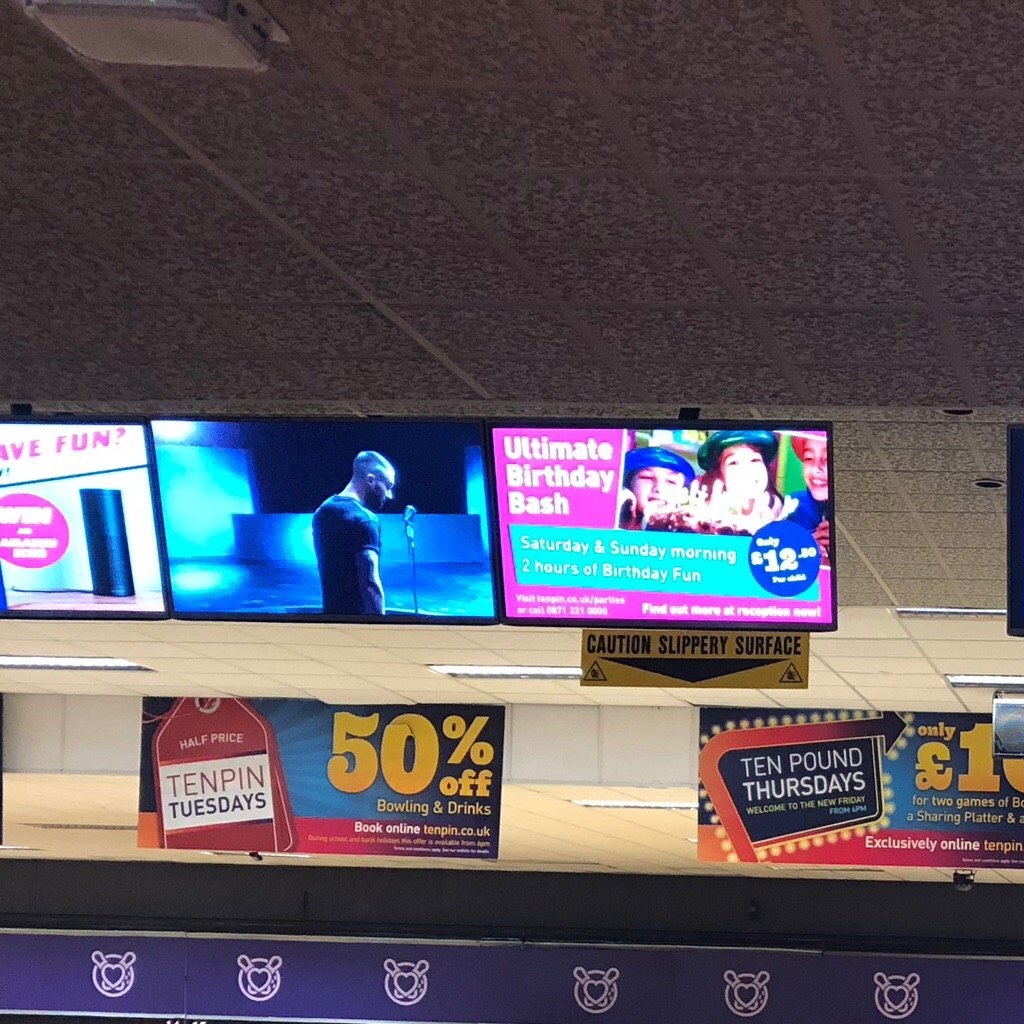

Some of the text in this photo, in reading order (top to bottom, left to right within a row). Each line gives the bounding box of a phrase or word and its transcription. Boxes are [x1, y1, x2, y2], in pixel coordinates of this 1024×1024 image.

[56, 427, 125, 453] FUN?
[503, 435, 613, 460] Ultimate
[506, 464, 615, 493] Birthday
[508, 491, 570, 515] Bash
[520, 535, 737, 565] Saturday & Sunday morning
[522, 559, 701, 583] 2 hours of Birthday Fun
[528, 606, 544, 614] call
[642, 603, 668, 615] Find
[669, 604, 689, 615] out
[690, 605, 721, 615] more
[723, 605, 735, 616] at
[737, 605, 791, 618] reception
[587, 634, 802, 656] CAUTION SLIPPERY SURFACE
[179, 733, 244, 750] HALF PRICE
[918, 721, 956, 741] only
[327, 711, 494, 795] 50%
[740, 747, 863, 778] TEN POUND
[166, 765, 264, 798] TENPIN
[439, 768, 493, 797] off
[742, 771, 866, 801] THURSDAYS
[168, 792, 267, 819] TUESDAYS
[377, 799, 491, 817] Bowling & Drinks
[746, 796, 866, 815] WELCOME TO THE NEW FRIDAY
[829, 805, 867, 815] FROM 6PM
[912, 795, 926, 806] for
[932, 797, 952, 806] two
[956, 798, 995, 809] games
[998, 796, 1010, 807] of
[906, 813, 914, 821] a
[917, 810, 961, 825] Sharing
[964, 812, 1004, 823] Platter
[1006, 813, 1015, 824] &
[354, 822, 491, 837] Book online tenpin.co.uk
[865, 835, 938, 852] Exclusively
[940, 837, 980, 851] online
